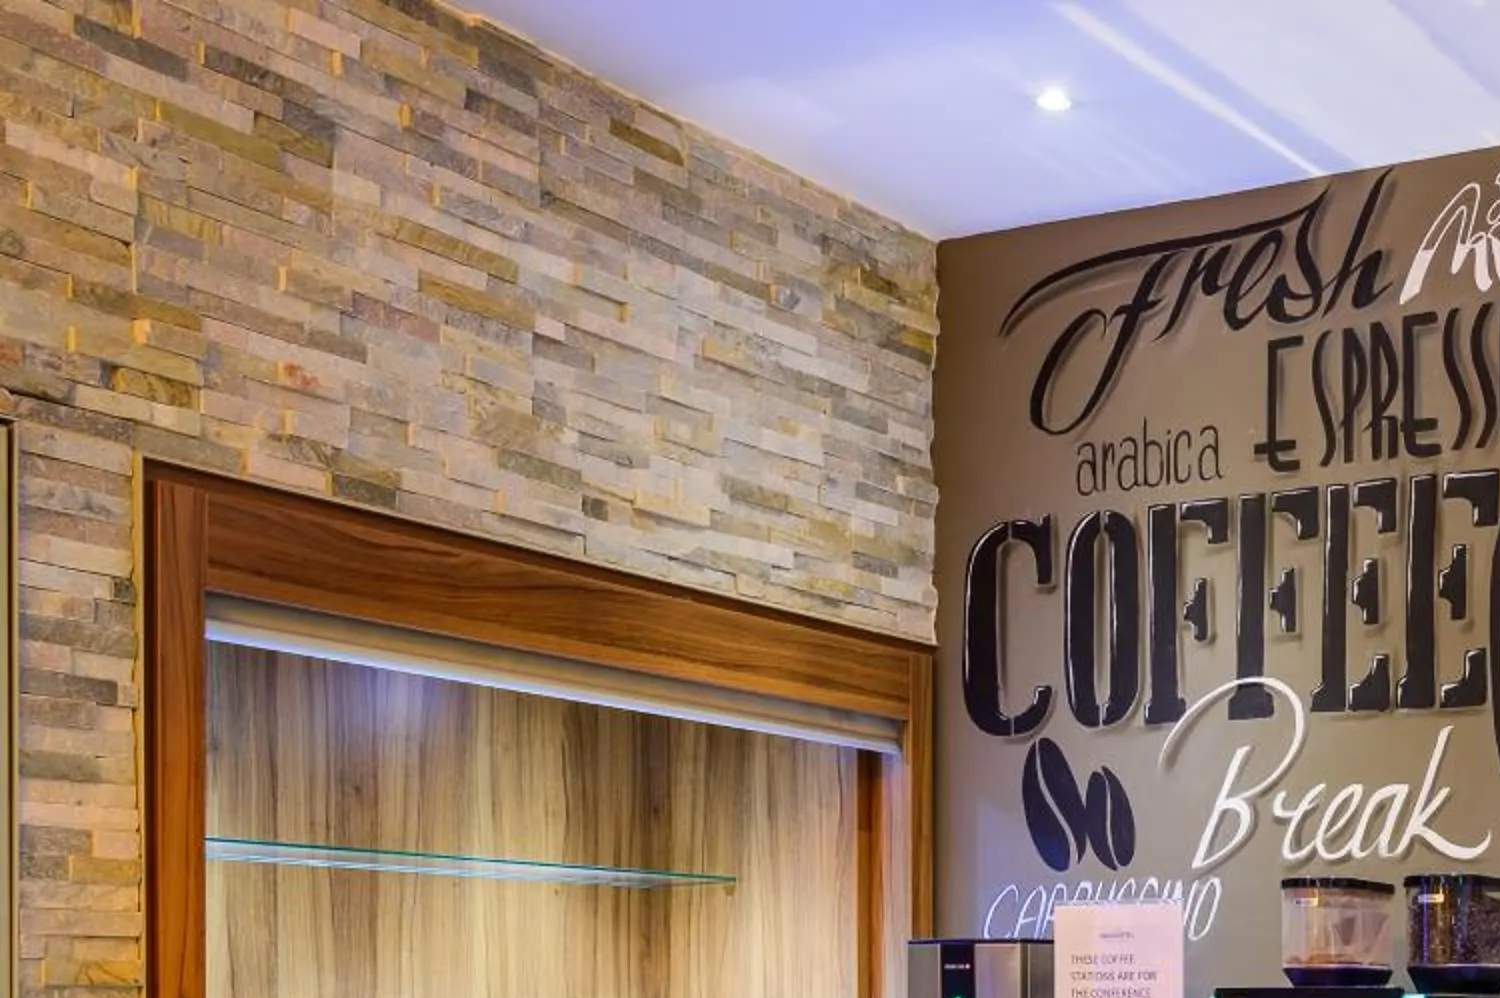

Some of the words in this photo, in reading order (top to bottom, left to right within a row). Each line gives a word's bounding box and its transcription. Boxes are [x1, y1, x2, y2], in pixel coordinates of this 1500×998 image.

[1000, 165, 1397, 436] Fresh
[1076, 417, 1224, 496] arabica
[963, 469, 1500, 738] COFFEE
[1158, 677, 1493, 870] Break
[1070, 954, 1098, 966] THESE
[1101, 954, 1135, 966] COFFEE
[1070, 988, 1089, 998] THE
[1090, 988, 1152, 998] CONFERENCE
[1117, 971, 1136, 982] ARE
[1137, 971, 1158, 982] FOR
